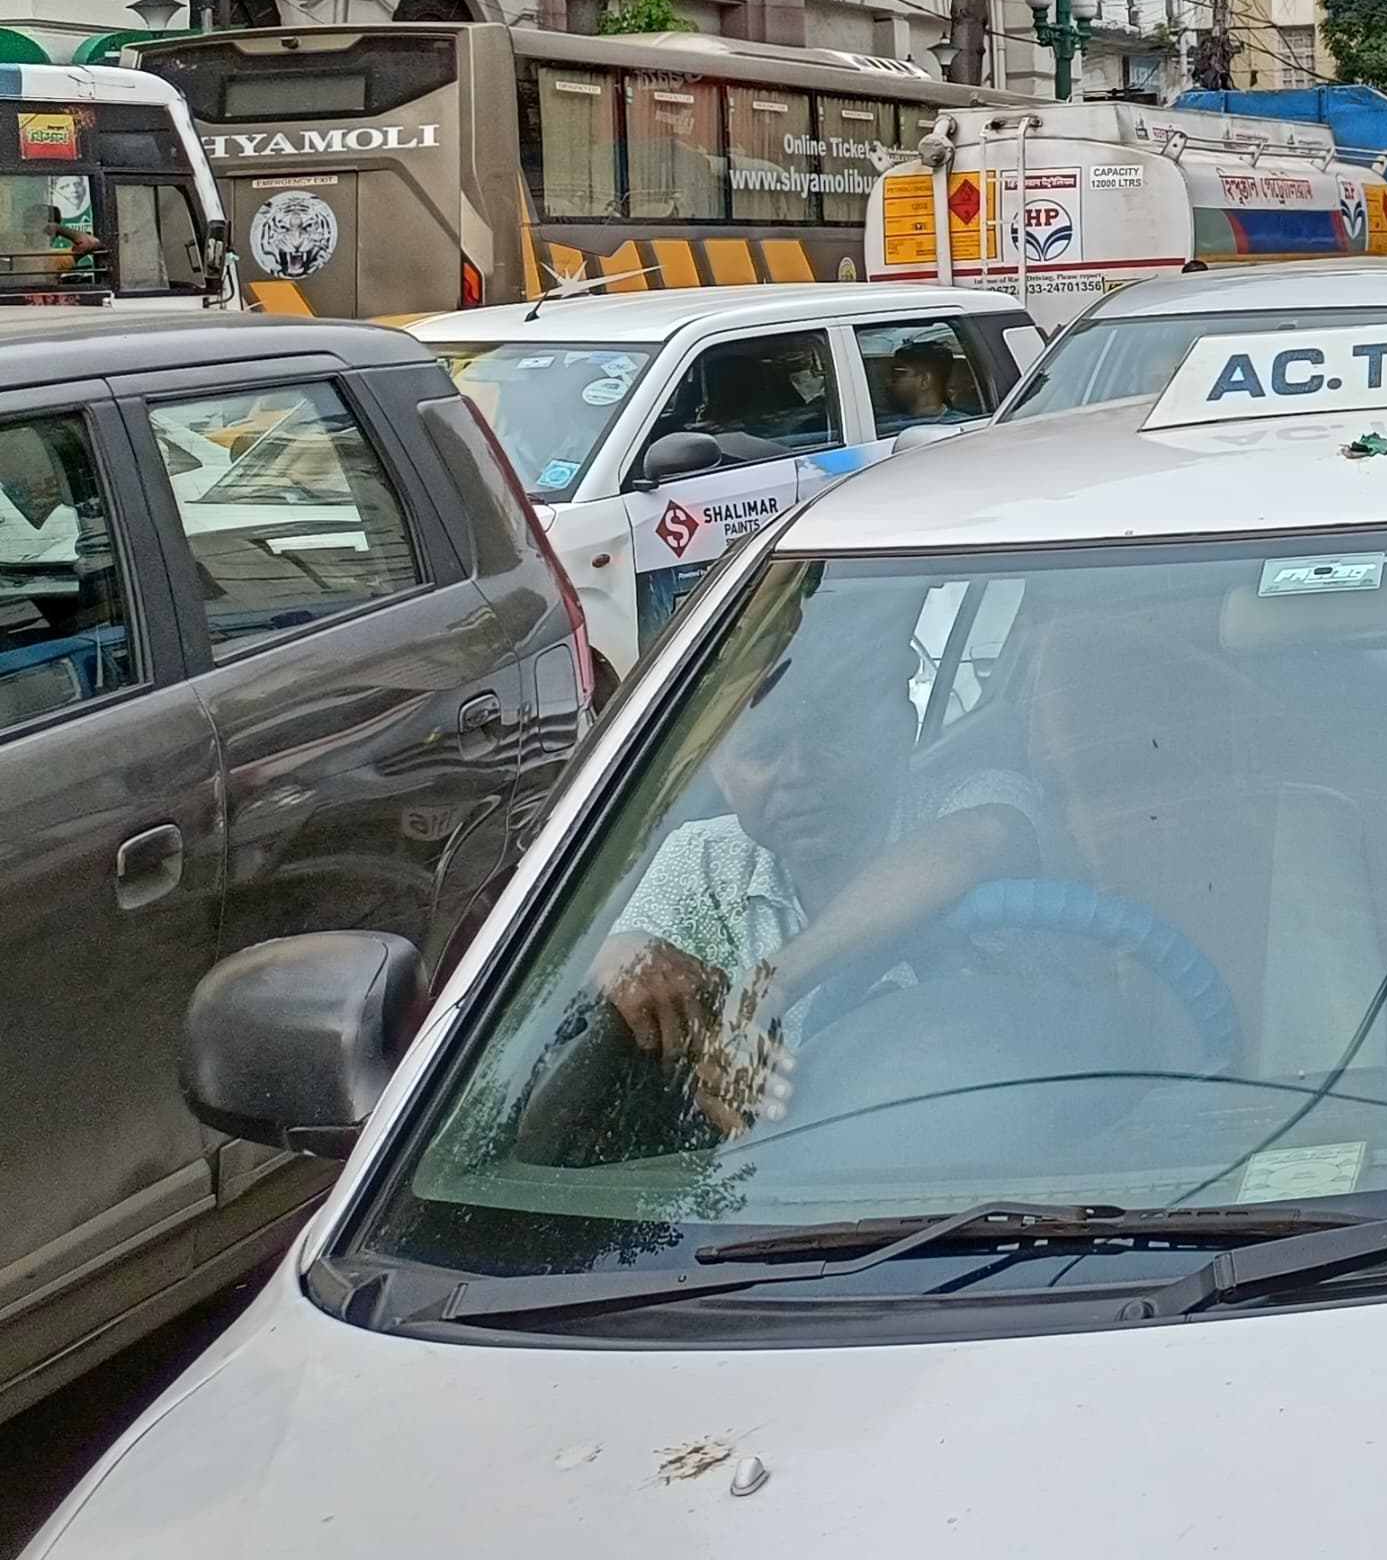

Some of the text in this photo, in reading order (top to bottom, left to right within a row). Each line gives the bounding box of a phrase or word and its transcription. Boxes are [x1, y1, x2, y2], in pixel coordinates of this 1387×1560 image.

[200, 123, 440, 158] HYAMOLI
[783, 133, 826, 155] Online
[829, 137, 870, 159] Ticket
[256, 176, 335, 188] EMERGENCY EXIT
[1093, 167, 1140, 178] CAPACITY
[1091, 177, 1142, 188] 12000 LTRS
[1026, 208, 1060, 227] HP
[1056, 273, 1078, 281] Please
[703, 497, 779, 524] SHALIMAR
[724, 518, 761, 537] PAINTS
